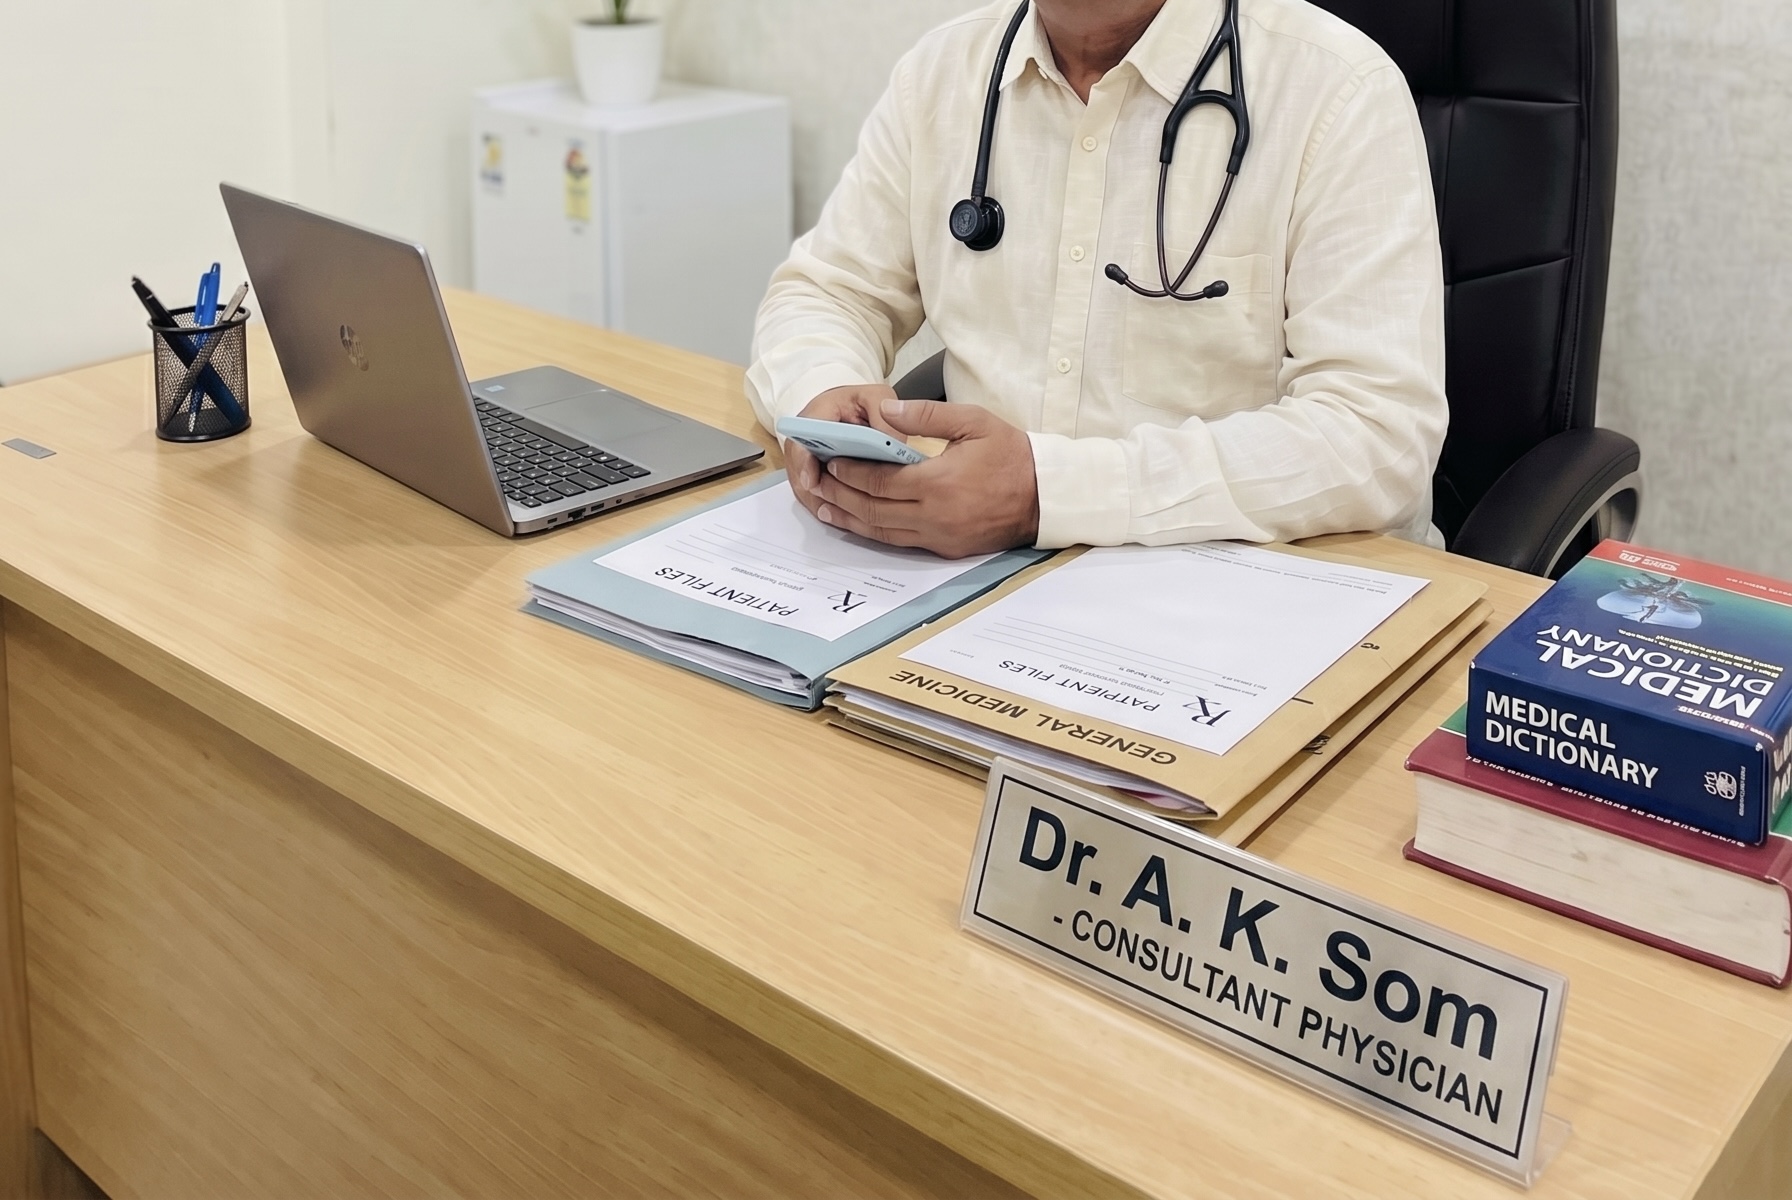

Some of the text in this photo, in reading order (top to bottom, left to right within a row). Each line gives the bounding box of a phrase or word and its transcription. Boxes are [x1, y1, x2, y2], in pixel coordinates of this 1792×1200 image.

[655, 566, 713, 590] FILES
[708, 584, 799, 617] PATIENT
[889, 669, 1029, 719] MEDICINE
[999, 660, 1055, 682] FILES
[1056, 678, 1160, 712] PATPIENT
[1536, 639, 1763, 718] MEDICAL
[1035, 713, 1177, 766] GENERAL
[1485, 690, 1616, 749] MEDICAL
[1485, 718, 1659, 789] DICTIONARY
[1018, 806, 1498, 1060] Dr. A. K. Som
[1072, 909, 1291, 1029] CONSULTANT
[1298, 1006, 1503, 1125] PHYSICIAN
